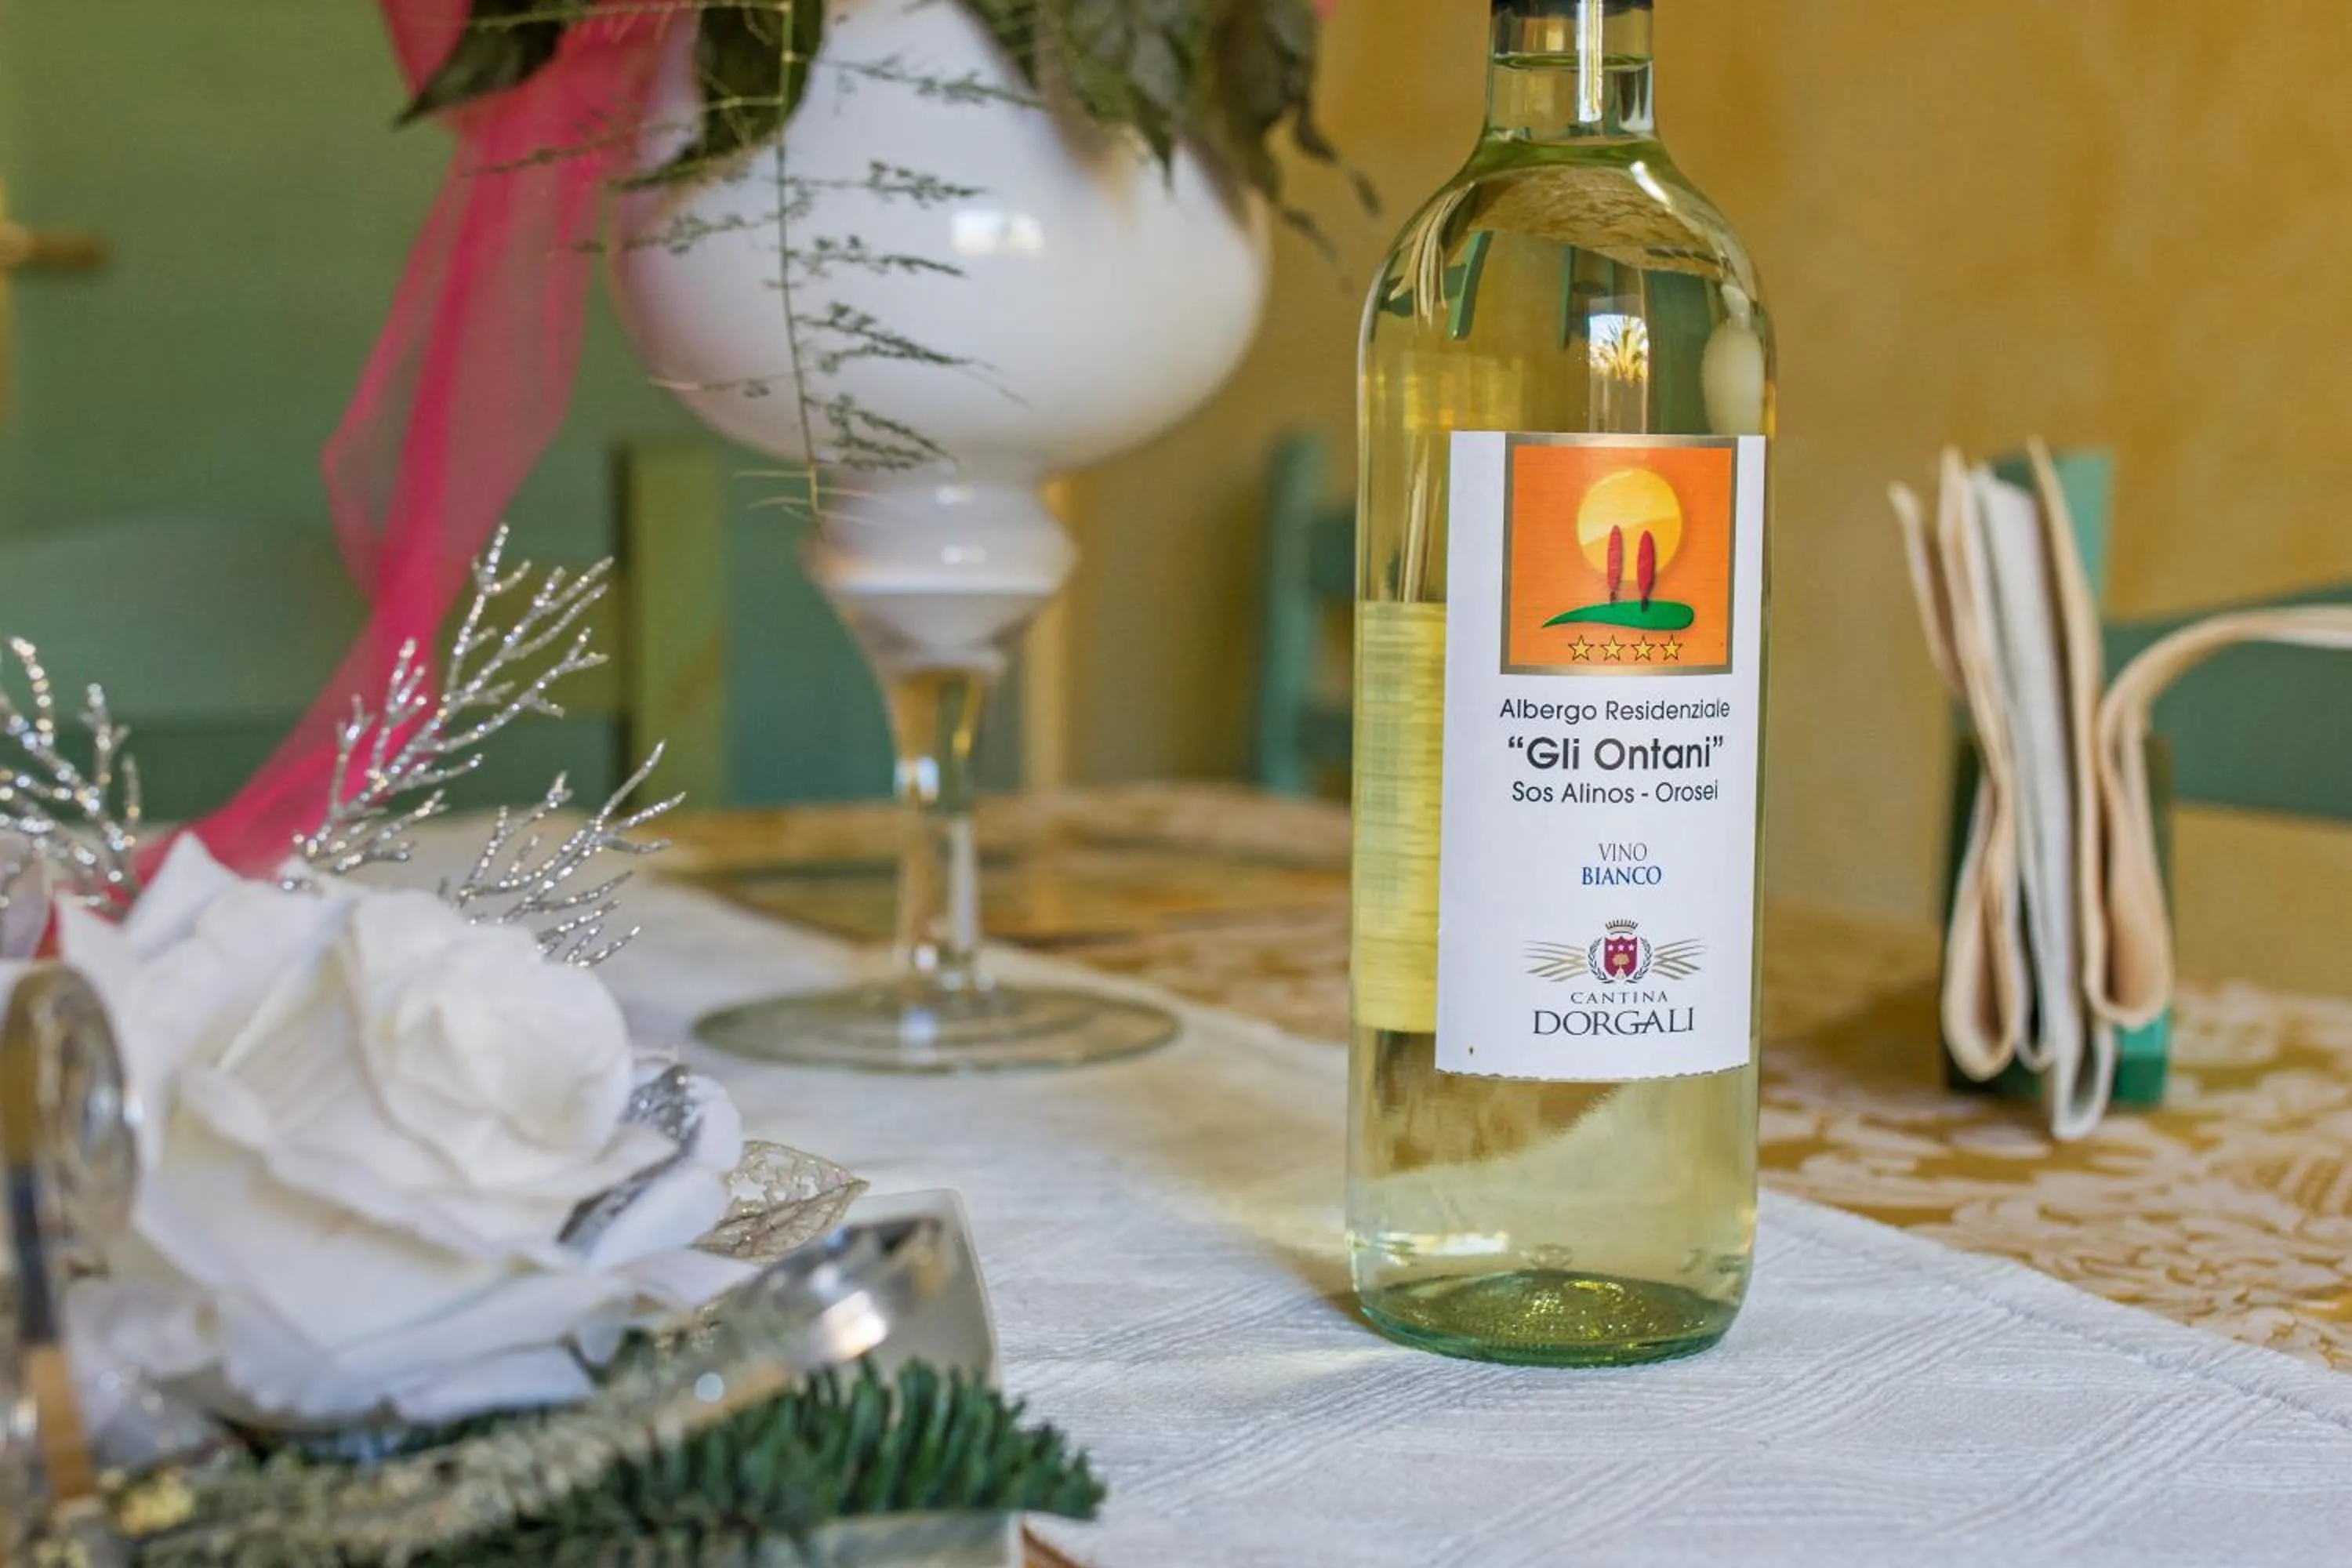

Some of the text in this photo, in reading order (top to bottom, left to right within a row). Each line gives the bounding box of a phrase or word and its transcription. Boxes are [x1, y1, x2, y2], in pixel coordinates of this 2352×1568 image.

[1500, 699, 1730, 724] Albergo Residenziale
[1508, 736, 1723, 770] “Gli Ontani”
[1512, 782, 1553, 802] Sos
[1562, 783, 1635, 804] Alinos
[1656, 780, 1719, 801] Orosei
[1599, 843, 1647, 862] VINO
[1582, 866, 1662, 885] BIANCO
[1570, 991, 1668, 1004] CANTINA
[1534, 1007, 1694, 1036] DORGALI
